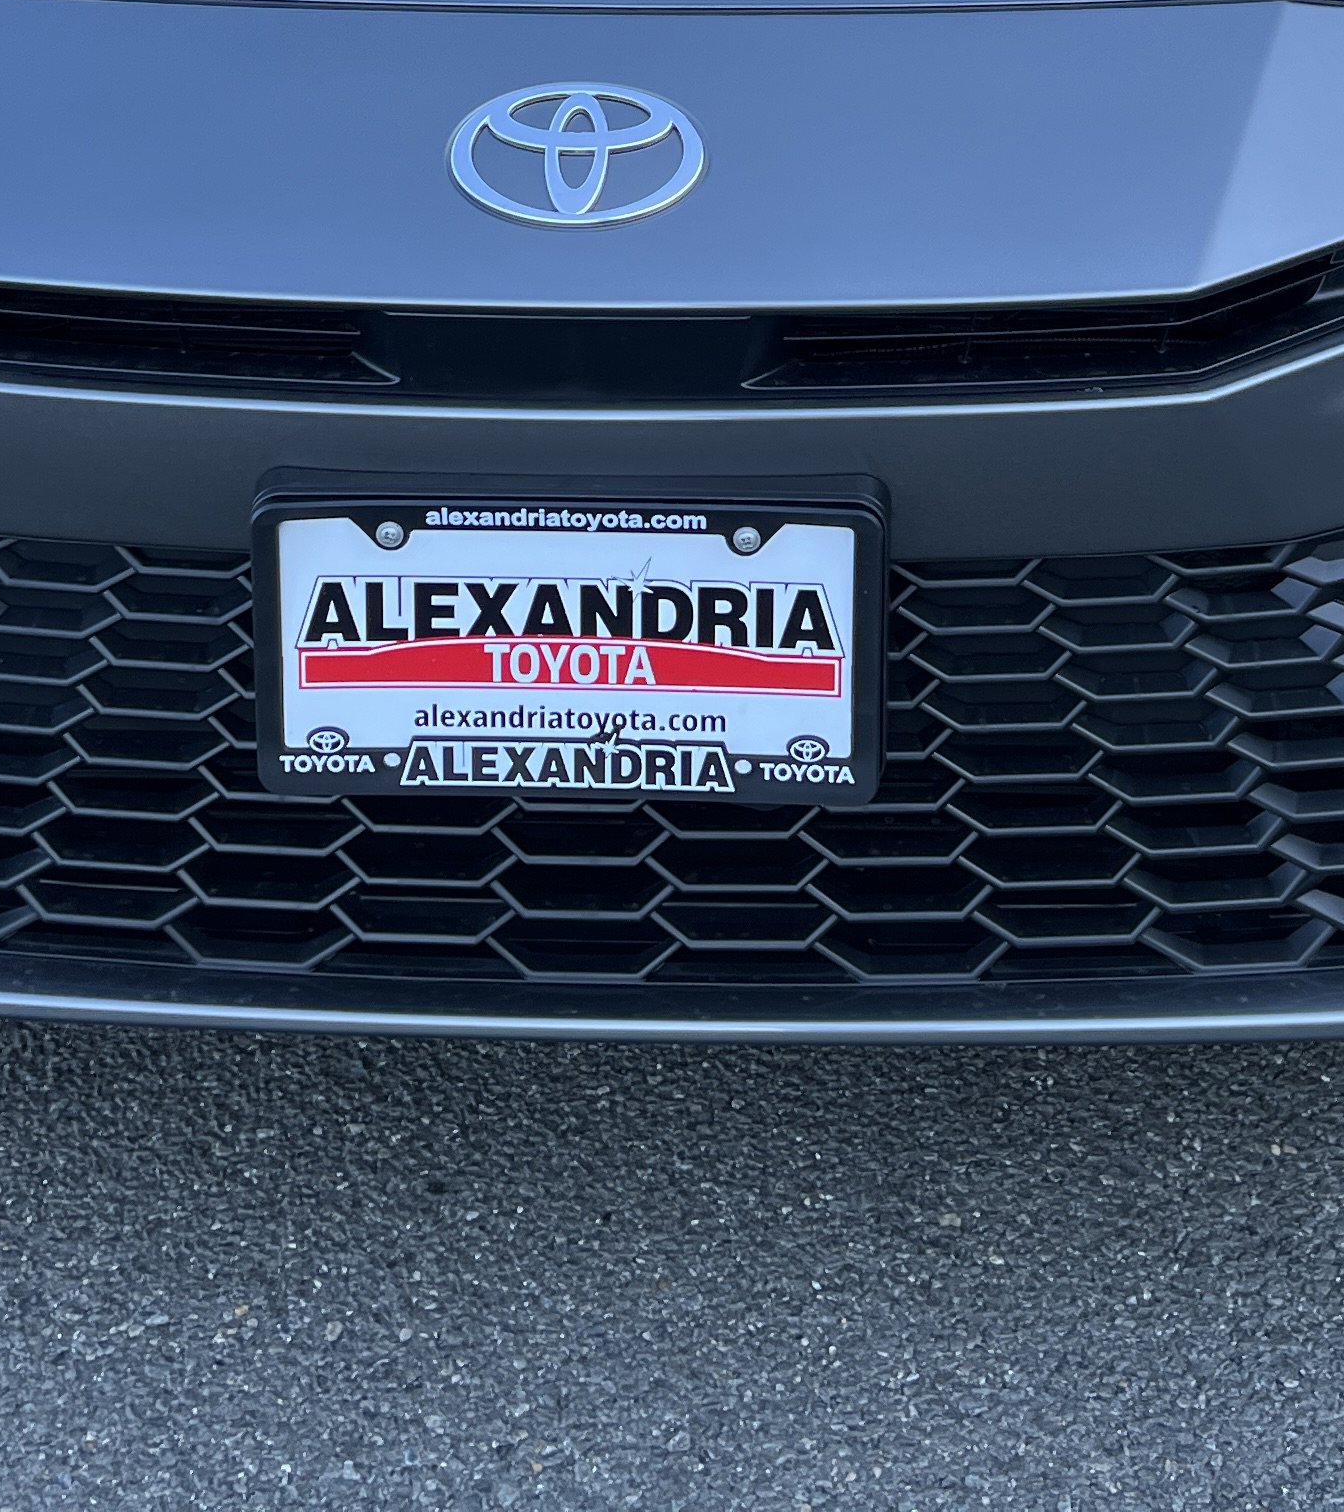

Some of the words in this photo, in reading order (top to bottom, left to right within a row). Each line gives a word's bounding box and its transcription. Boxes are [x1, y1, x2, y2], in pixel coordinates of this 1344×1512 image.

[425, 507, 707, 532] alexandriatoyota.com
[301, 577, 839, 654] ALEXANDRIA
[484, 642, 657, 685] TOYOTA
[414, 703, 726, 733] alexandriatoyota.com
[279, 755, 375, 774] TOYOTA
[402, 742, 733, 791] ALEXANDRIA
[759, 763, 856, 785] TOYOTA
